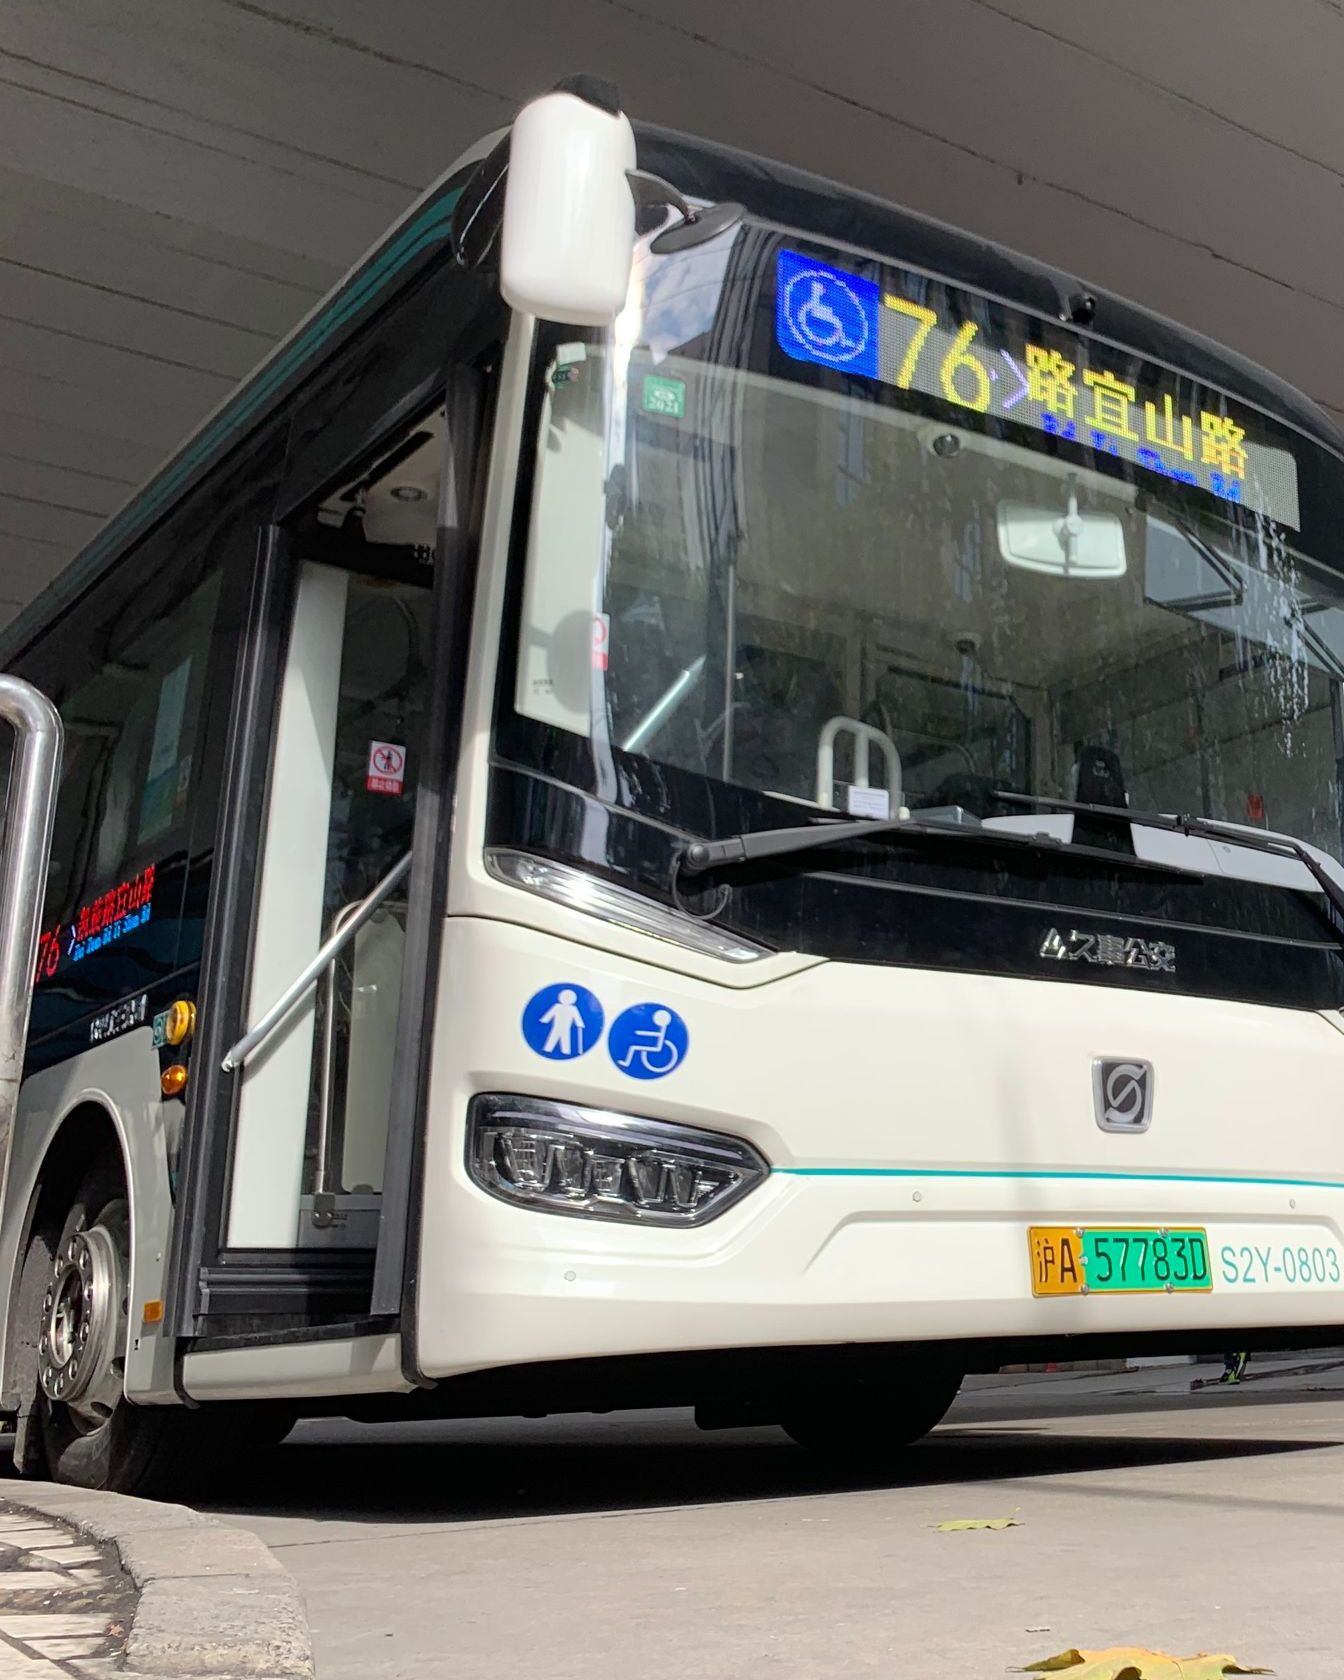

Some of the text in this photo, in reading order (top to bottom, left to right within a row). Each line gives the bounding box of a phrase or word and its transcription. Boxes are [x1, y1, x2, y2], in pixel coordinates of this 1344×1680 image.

[884, 292, 991, 413] 76
[1024, 342, 1248, 480] 路宜山路
[1093, 1237, 1208, 1283] 57783D
[1220, 1246, 1341, 1284] S2Y-0803
